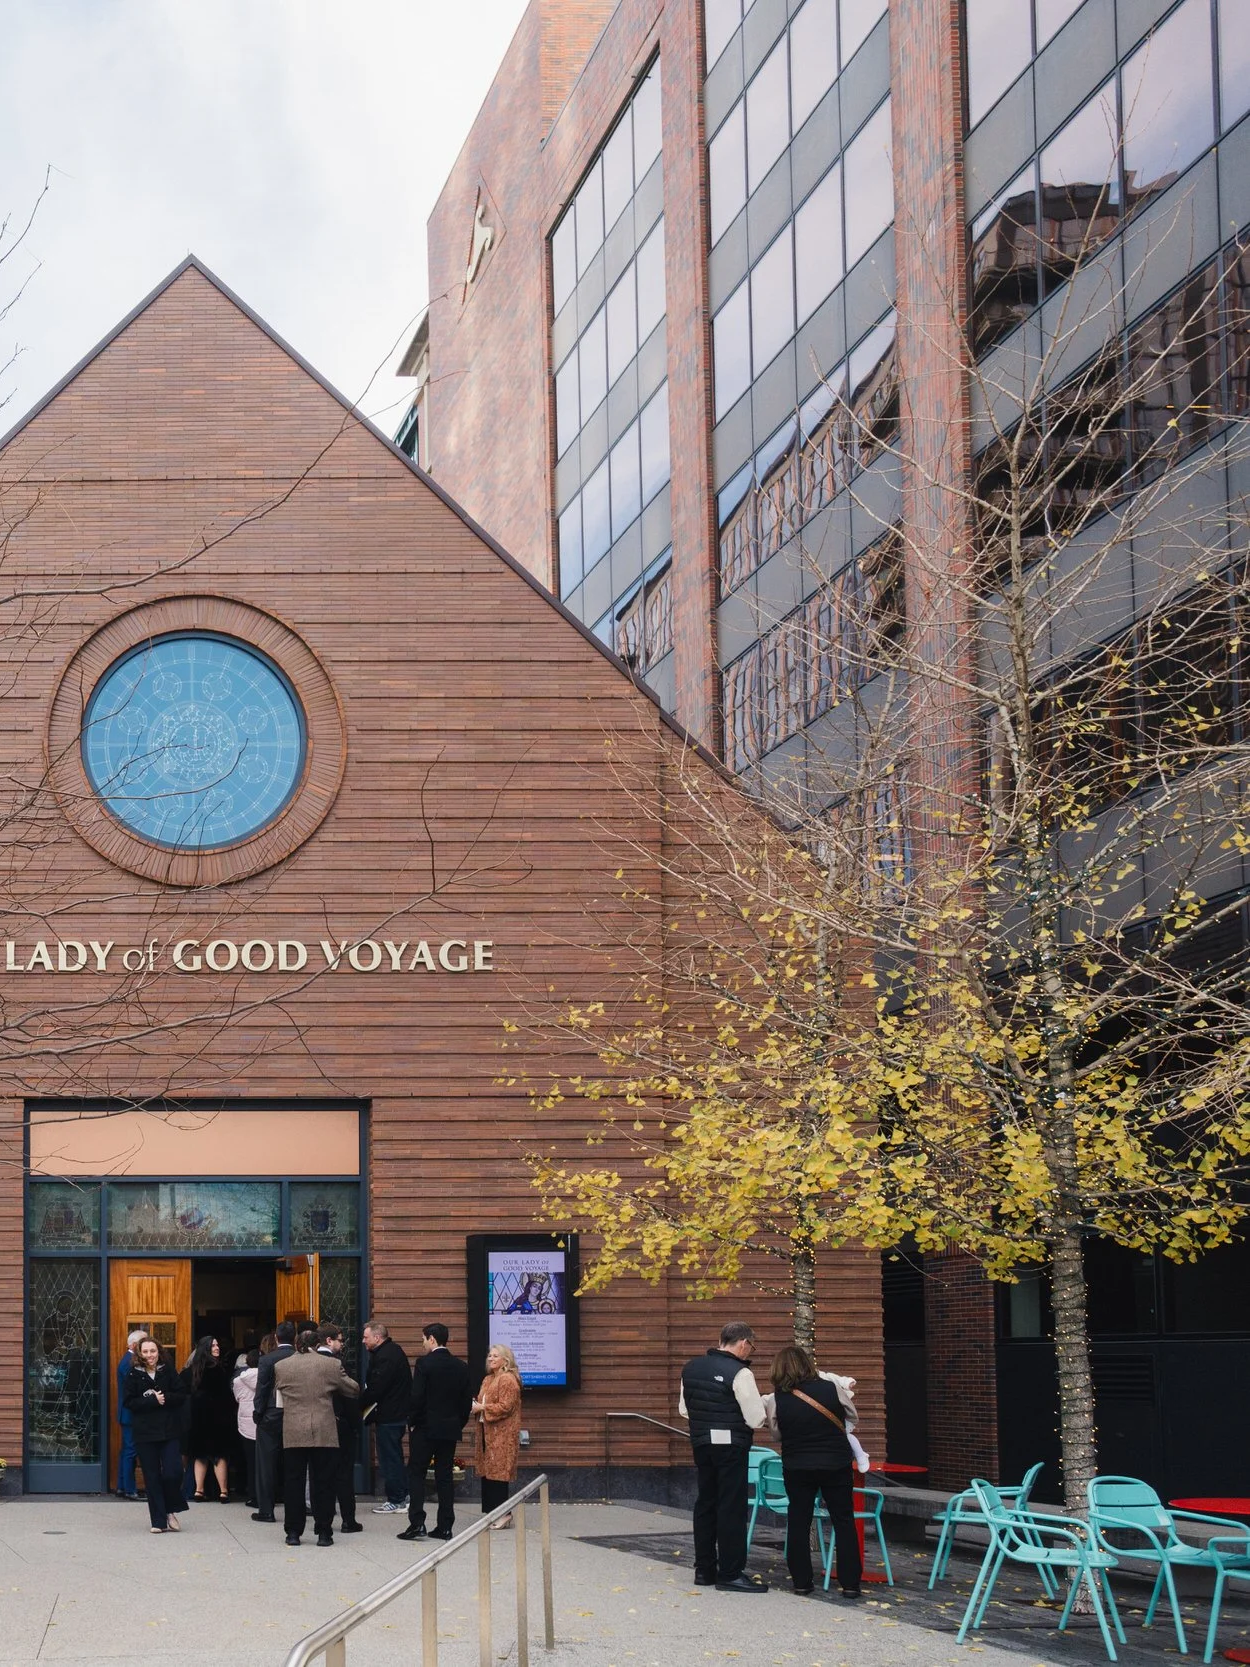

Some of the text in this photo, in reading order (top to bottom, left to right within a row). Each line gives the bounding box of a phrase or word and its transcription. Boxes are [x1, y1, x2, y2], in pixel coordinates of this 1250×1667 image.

[6, 940, 115, 972] LADY
[122, 938, 158, 972] of
[172, 939, 308, 972] GOOD
[320, 939, 494, 972] VOYAGE
